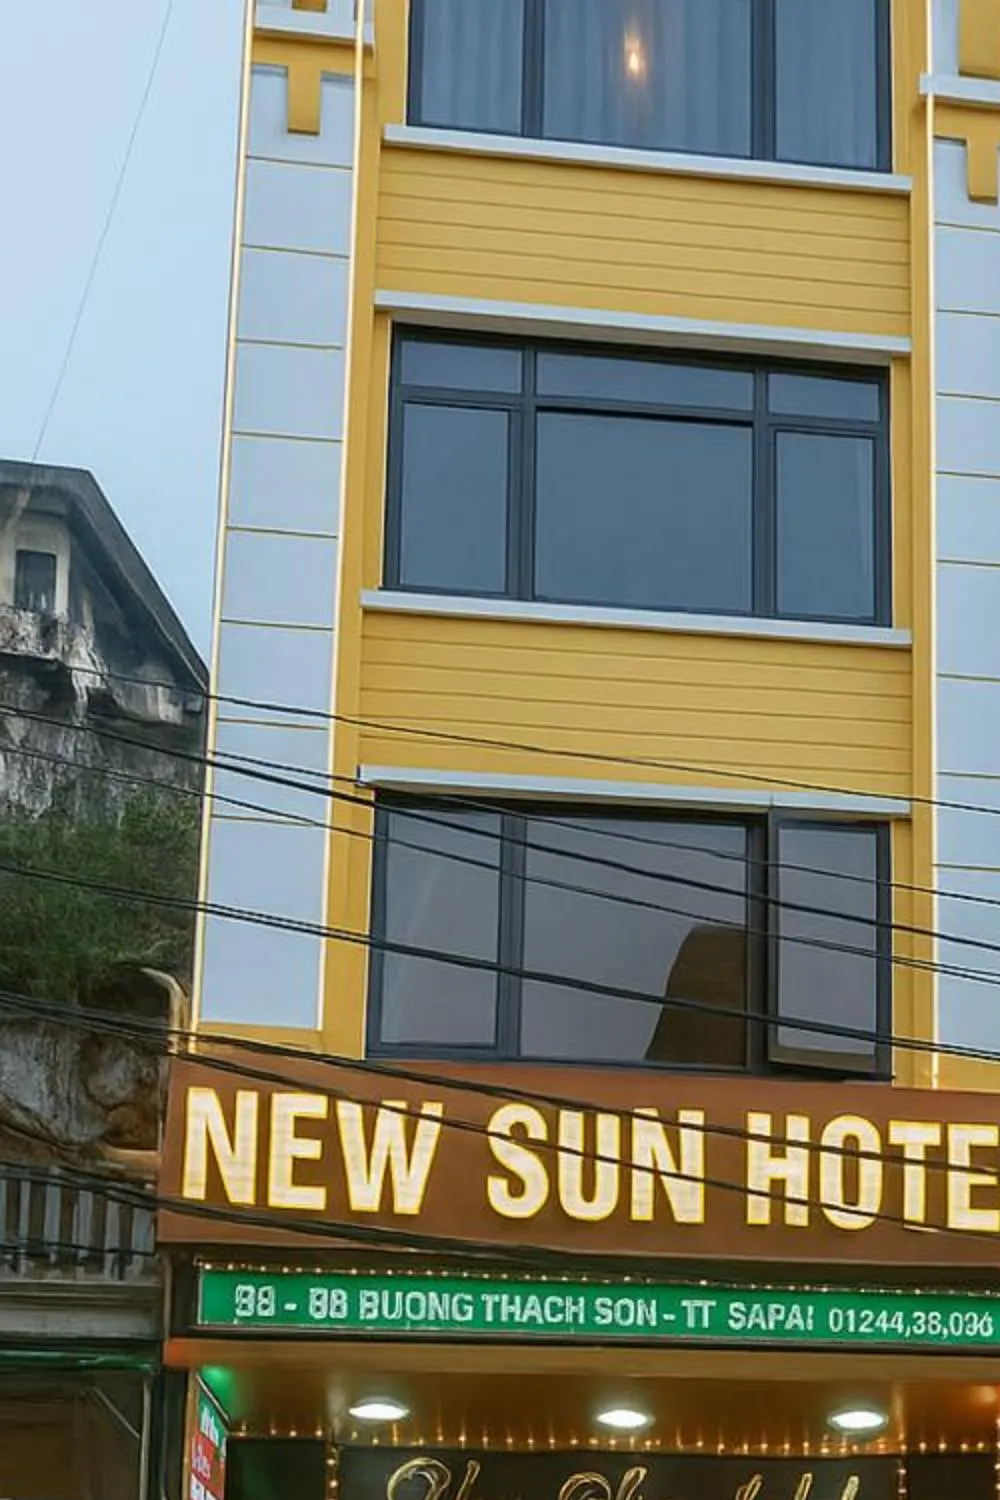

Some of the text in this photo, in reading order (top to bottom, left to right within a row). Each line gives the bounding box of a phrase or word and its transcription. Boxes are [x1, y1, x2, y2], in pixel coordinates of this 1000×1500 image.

[181, 1086, 444, 1216] NEW
[487, 1102, 706, 1225] SUN
[481, 1293, 586, 1325] THACH
[594, 1297, 658, 1327] SON
[681, 1299, 718, 1329] TT
